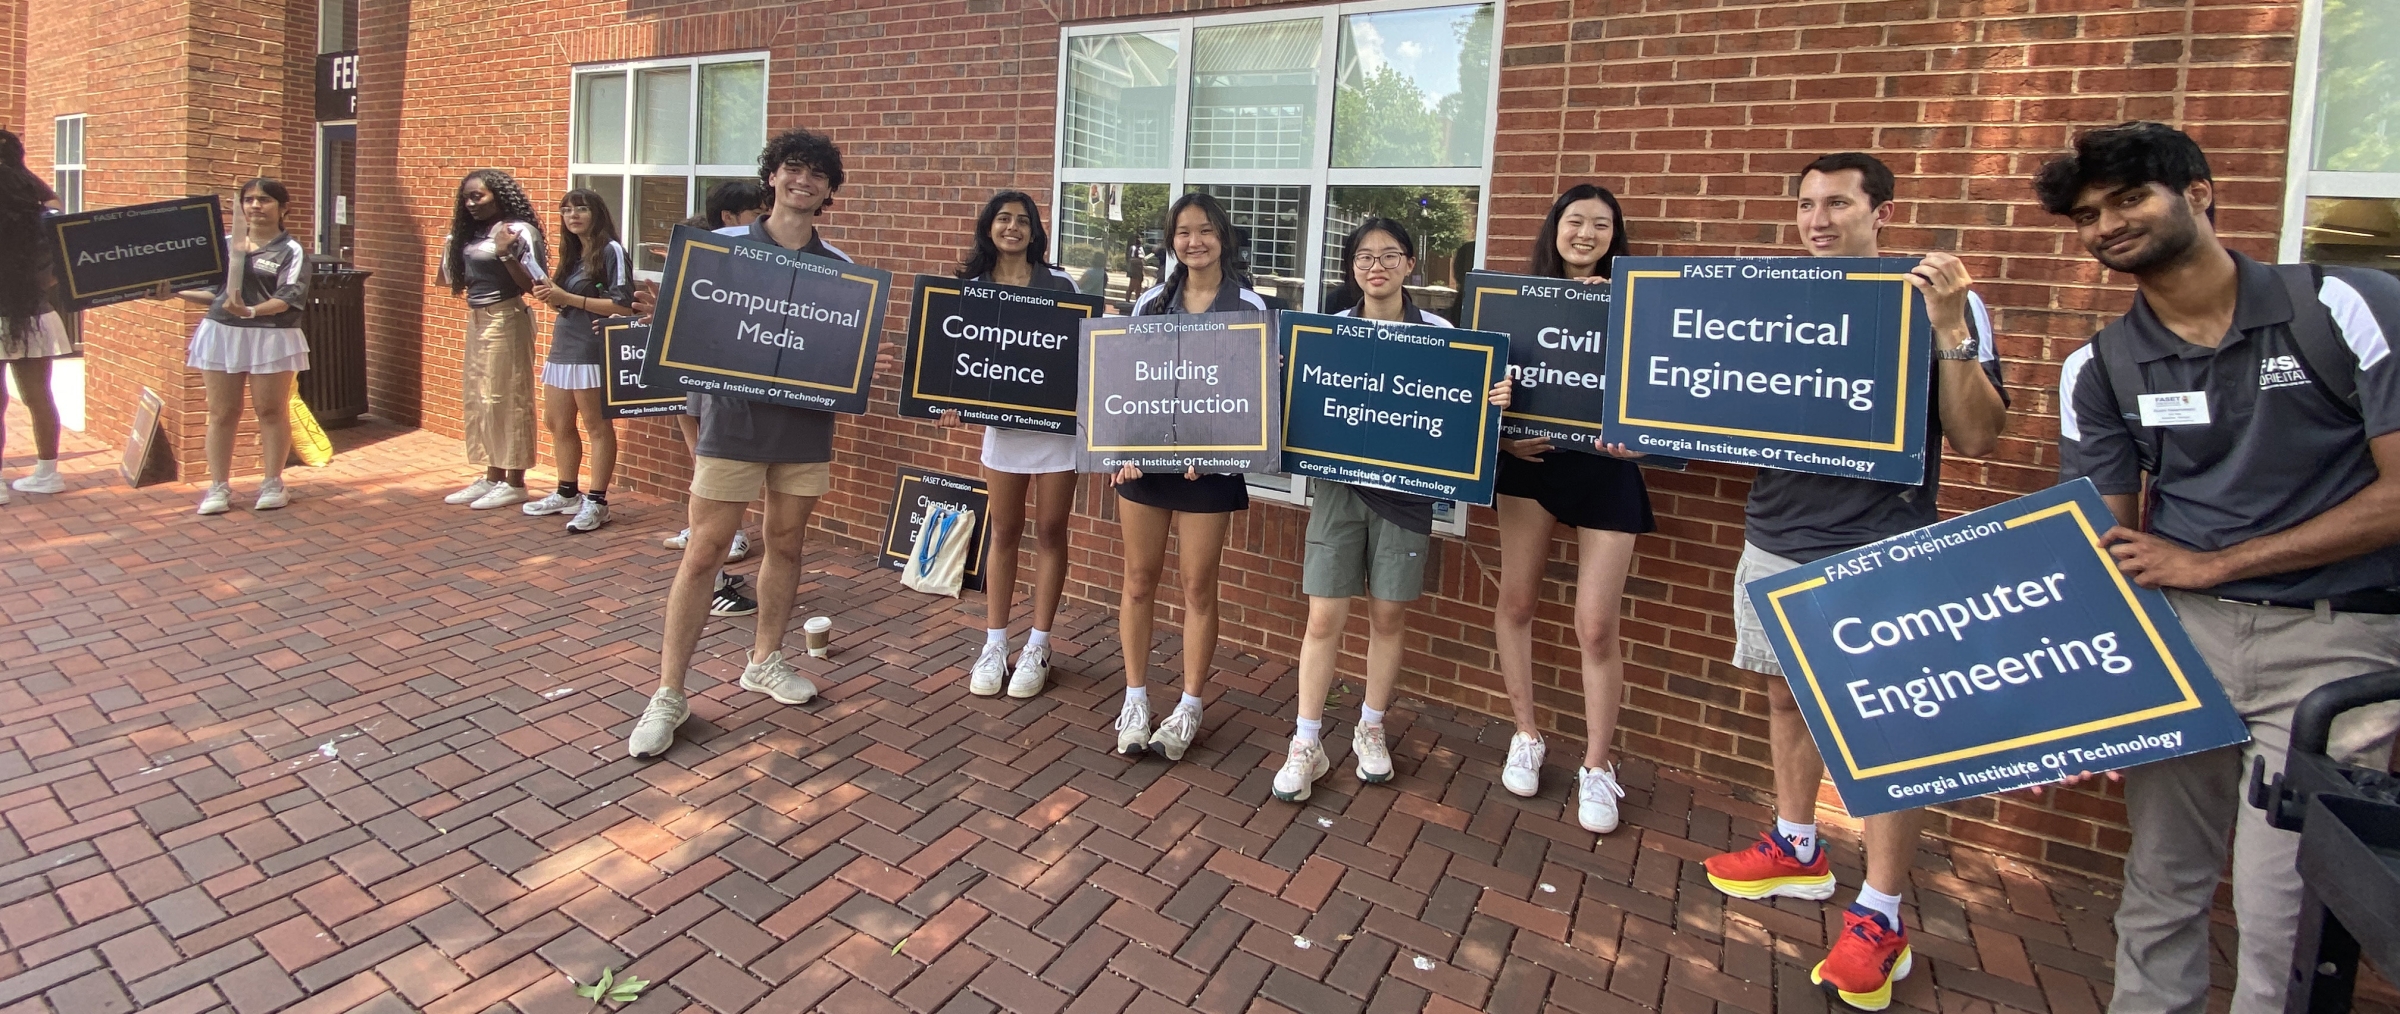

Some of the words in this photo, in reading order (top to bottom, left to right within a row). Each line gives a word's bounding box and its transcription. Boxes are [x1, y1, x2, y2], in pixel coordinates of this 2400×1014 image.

[77, 234, 208, 267] Architecture
[734, 245, 773, 262] FASET
[776, 254, 838, 277] Orientation
[1683, 265, 1736, 279] FASET
[1741, 265, 1843, 281] Orientation
[690, 278, 860, 328] Computational
[964, 286, 996, 299] FASET
[998, 291, 1054, 306] Orientation
[1521, 285, 1561, 299] FASET
[1564, 288, 1611, 302] Orienta
[736, 320, 804, 350] Media
[942, 315, 1068, 350] Computer
[1128, 323, 1162, 334] FASET
[1164, 321, 1224, 333] Orientation
[1336, 324, 1375, 339] FASET
[1378, 328, 1445, 347] Orientation
[1537, 326, 1601, 353] Civil
[1672, 308, 1849, 346] Electrical
[956, 353, 1044, 384] Science
[1136, 360, 1218, 385] Building
[1302, 364, 1384, 393] Material
[1392, 375, 1472, 404] Science
[1649, 356, 1874, 411] Engineering
[679, 376, 720, 390] Georgia
[723, 382, 765, 395] Institute
[768, 388, 780, 396] Of
[784, 390, 836, 406] Technology
[1104, 394, 1249, 415] Construction
[928, 406, 961, 417] Geoa
[964, 409, 999, 421] Institute
[1001, 414, 1013, 422] Of
[1014, 415, 1061, 429] Technology
[1323, 397, 1444, 438] Engineering
[1525, 426, 1568, 440] Institute
[1571, 433, 1585, 442] Of
[1142, 458, 1181, 467] Institute
[1183, 457, 1197, 466] Of
[1197, 458, 1251, 468] Technology
[1638, 434, 1692, 452] Georgia
[1696, 439, 1758, 458] Institute
[1761, 447, 1782, 460] Of
[1784, 448, 1875, 472] Technology
[922, 475, 940, 485] FASET
[941, 479, 971, 492] Orientation
[1299, 460, 1337, 474] Georgia
[1339, 466, 1380, 482] Institute
[1383, 473, 1397, 484] Of
[1399, 475, 1456, 494] Technology
[1824, 551, 1882, 583] FASET
[1889, 519, 2003, 563] Orientation
[1832, 570, 2066, 655] Computer
[1846, 630, 2133, 720] Engineering
[1887, 774, 1958, 800] Georgia
[1958, 761, 2040, 789] Institute
[2041, 753, 2068, 770] Of
[2069, 729, 2184, 764] Technology
